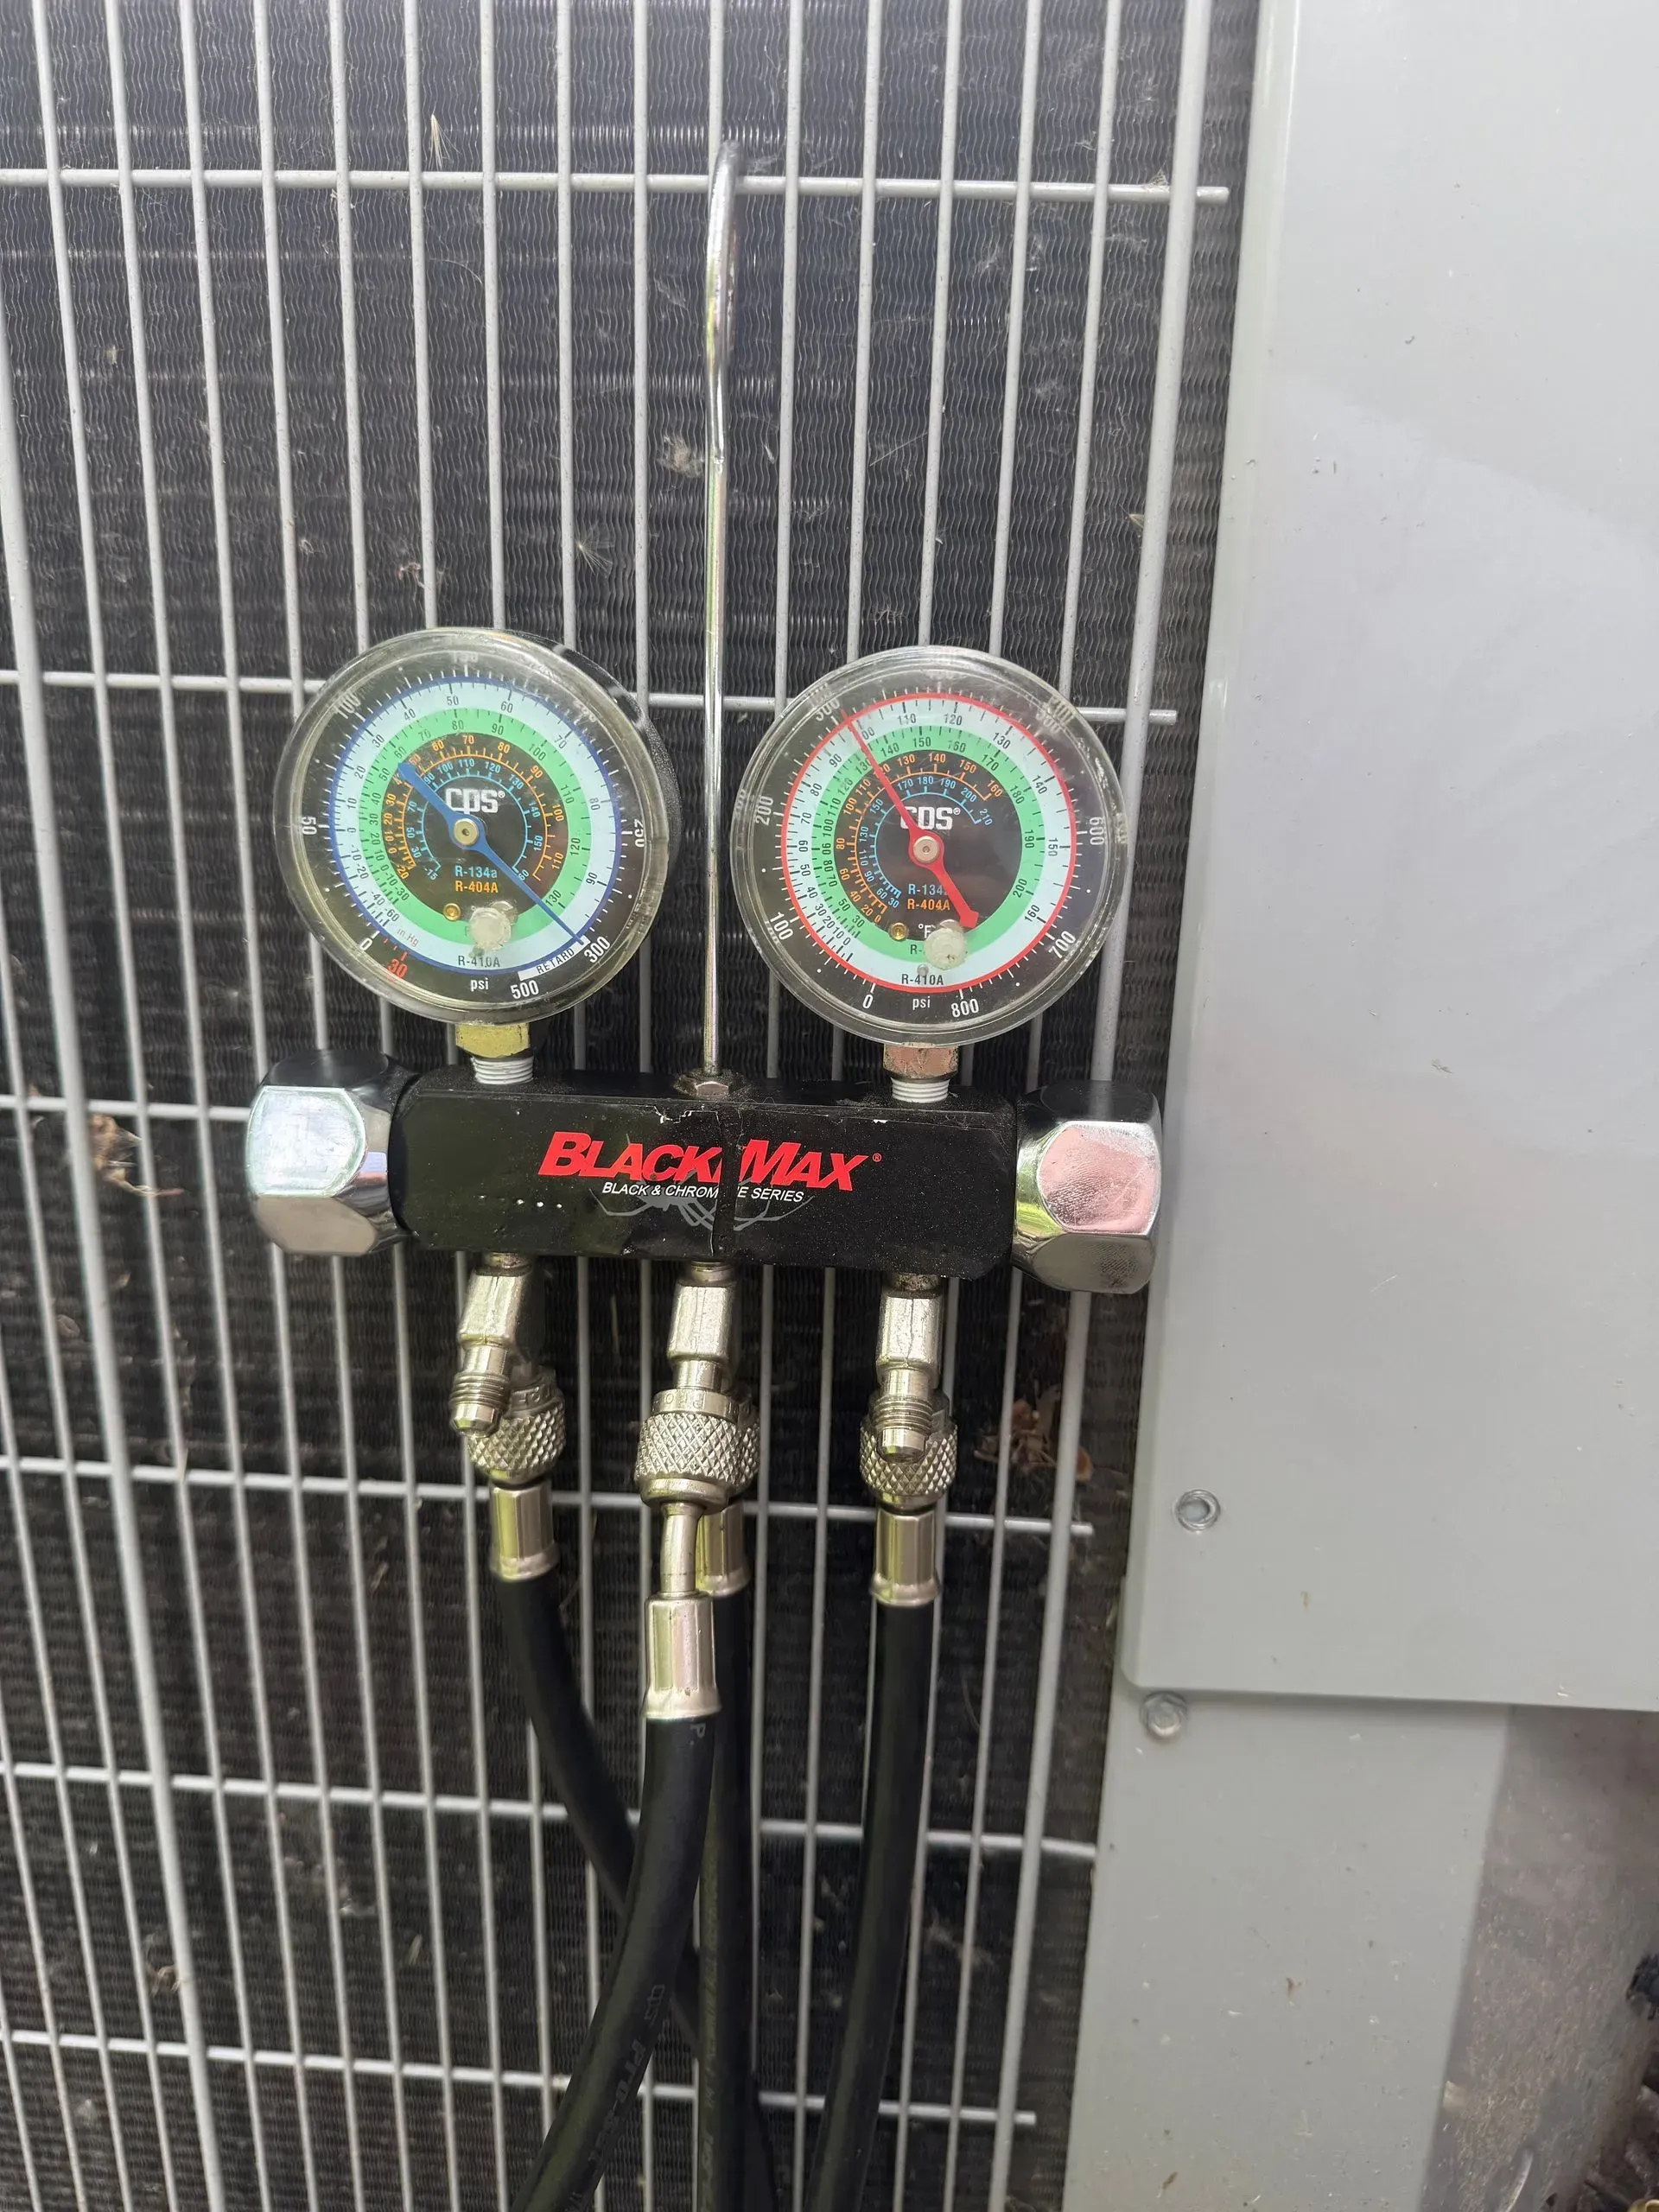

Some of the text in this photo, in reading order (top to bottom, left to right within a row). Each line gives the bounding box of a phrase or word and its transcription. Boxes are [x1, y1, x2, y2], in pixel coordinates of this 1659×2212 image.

[447, 696, 459, 706] 50
[500, 702, 513, 713] 60
[404, 709, 416, 721] 40
[944, 714, 963, 725] 120
[452, 720, 463, 730] 80
[492, 723, 504, 734] 90
[372, 734, 385, 748] 30
[432, 740, 444, 752] 60
[463, 735, 474, 744] 70
[554, 735, 567, 749] 70
[912, 737, 931, 747] 150
[993, 733, 1010, 749] 130
[394, 747, 407, 760] 60
[498, 742, 511, 753] 80
[528, 744, 546, 761] 100
[881, 743, 899, 757] 140
[459, 759, 474, 767] 110
[830, 753, 842, 768] 90
[898, 754, 915, 766] 130
[928, 753, 945, 763] 140
[982, 754, 1000, 771] 170
[354, 766, 365, 779] 20
[438, 764, 454, 774] 100
[485, 762, 501, 772] 120
[530, 766, 543, 779] 90
[959, 760, 977, 774] 150
[378, 768, 389, 781] 50
[509, 774, 524, 790] 130
[855, 779, 871, 796] 110
[898, 779, 913, 791] 170
[918, 777, 933, 786] 180
[940, 779, 956, 789] 190
[1033, 776, 1048, 794] 140
[561, 785, 574, 804] 110
[810, 783, 822, 797] 80
[961, 788, 977, 803] 200
[987, 780, 1003, 798] 160
[1009, 785, 1025, 804] 180
[347, 798, 357, 810] 10
[372, 792, 381, 804] 40
[385, 793, 397, 806] 30
[590, 798, 601, 810] 80
[407, 801, 417, 811] 70
[529, 800, 540, 817] 140
[756, 796, 774, 826] 200
[828, 798, 841, 816] 110
[843, 797, 857, 815] 100
[870, 798, 883, 813] 150
[370, 813, 378, 825] 30
[384, 813, 393, 825] 20
[552, 804, 564, 822] 100
[801, 812, 811, 825] 70
[980, 809, 993, 825] 210
[302, 817, 317, 835] 50
[823, 818, 834, 836] 100
[1089, 817, 1104, 845] 600
[371, 832, 379, 845] 20
[385, 830, 394, 841] 10
[407, 828, 415, 838] 50
[860, 827, 868, 842] 130
[1024, 830, 1034, 848] 190
[534, 836, 543, 851] 150
[570, 837, 581, 855] 120
[798, 840, 808, 852] 60
[822, 843, 831, 855] 90
[836, 838, 845, 849] 80
[1048, 838, 1058, 856] 150
[375, 849, 385, 861] 10
[410, 847, 422, 858] 30
[859, 850, 868, 866] 110
[552, 853, 564, 869] 110
[824, 860, 833, 872] 80
[357, 864, 368, 879] -20
[454, 866, 497, 877] R-134a
[800, 864, 810, 876] 50
[840, 868, 850, 880] 60
[864, 871, 874, 881] 90
[586, 872, 598, 885] 90
[827, 874, 837, 887] 70
[455, 880, 499, 893] R-404A
[807, 887, 817, 899] 40
[908, 884, 947, 894] R-134
[1013, 879, 1027, 898] 200
[371, 891, 385, 906] -40
[545, 890, 562, 906] 130
[849, 891, 861, 902] 40
[876, 888, 887, 899] 60
[838, 899, 850, 912] 50
[888, 898, 899, 908] 30
[907, 899, 950, 911] R-404A
[385, 908, 399, 922] -60
[815, 904, 827, 916] 30
[861, 905, 873, 916] 20
[1024, 905, 1040, 922] 160
[770, 912, 793, 940] 100
[823, 916, 836, 929] 20
[852, 916, 864, 928] 30
[834, 926, 844, 938] 10
[360, 938, 372, 950] 0
[584, 937, 611, 963] 300
[1048, 931, 1076, 959] 700
[458, 955, 500, 967] R-410A
[537, 948, 575, 974] RETARD
[388, 958, 407, 978] 30
[470, 978, 488, 991] psi
[901, 974, 944, 985] R-410A
[511, 980, 539, 999] 500
[863, 995, 874, 1008] 0
[912, 996, 930, 1009] psi
[951, 999, 979, 1017] 800
[538, 1131, 722, 1183] BLACK
[602, 1182, 650, 1196] BLACK
[652, 1184, 661, 1196] &
[751, 1187, 804, 1203] SERIES
